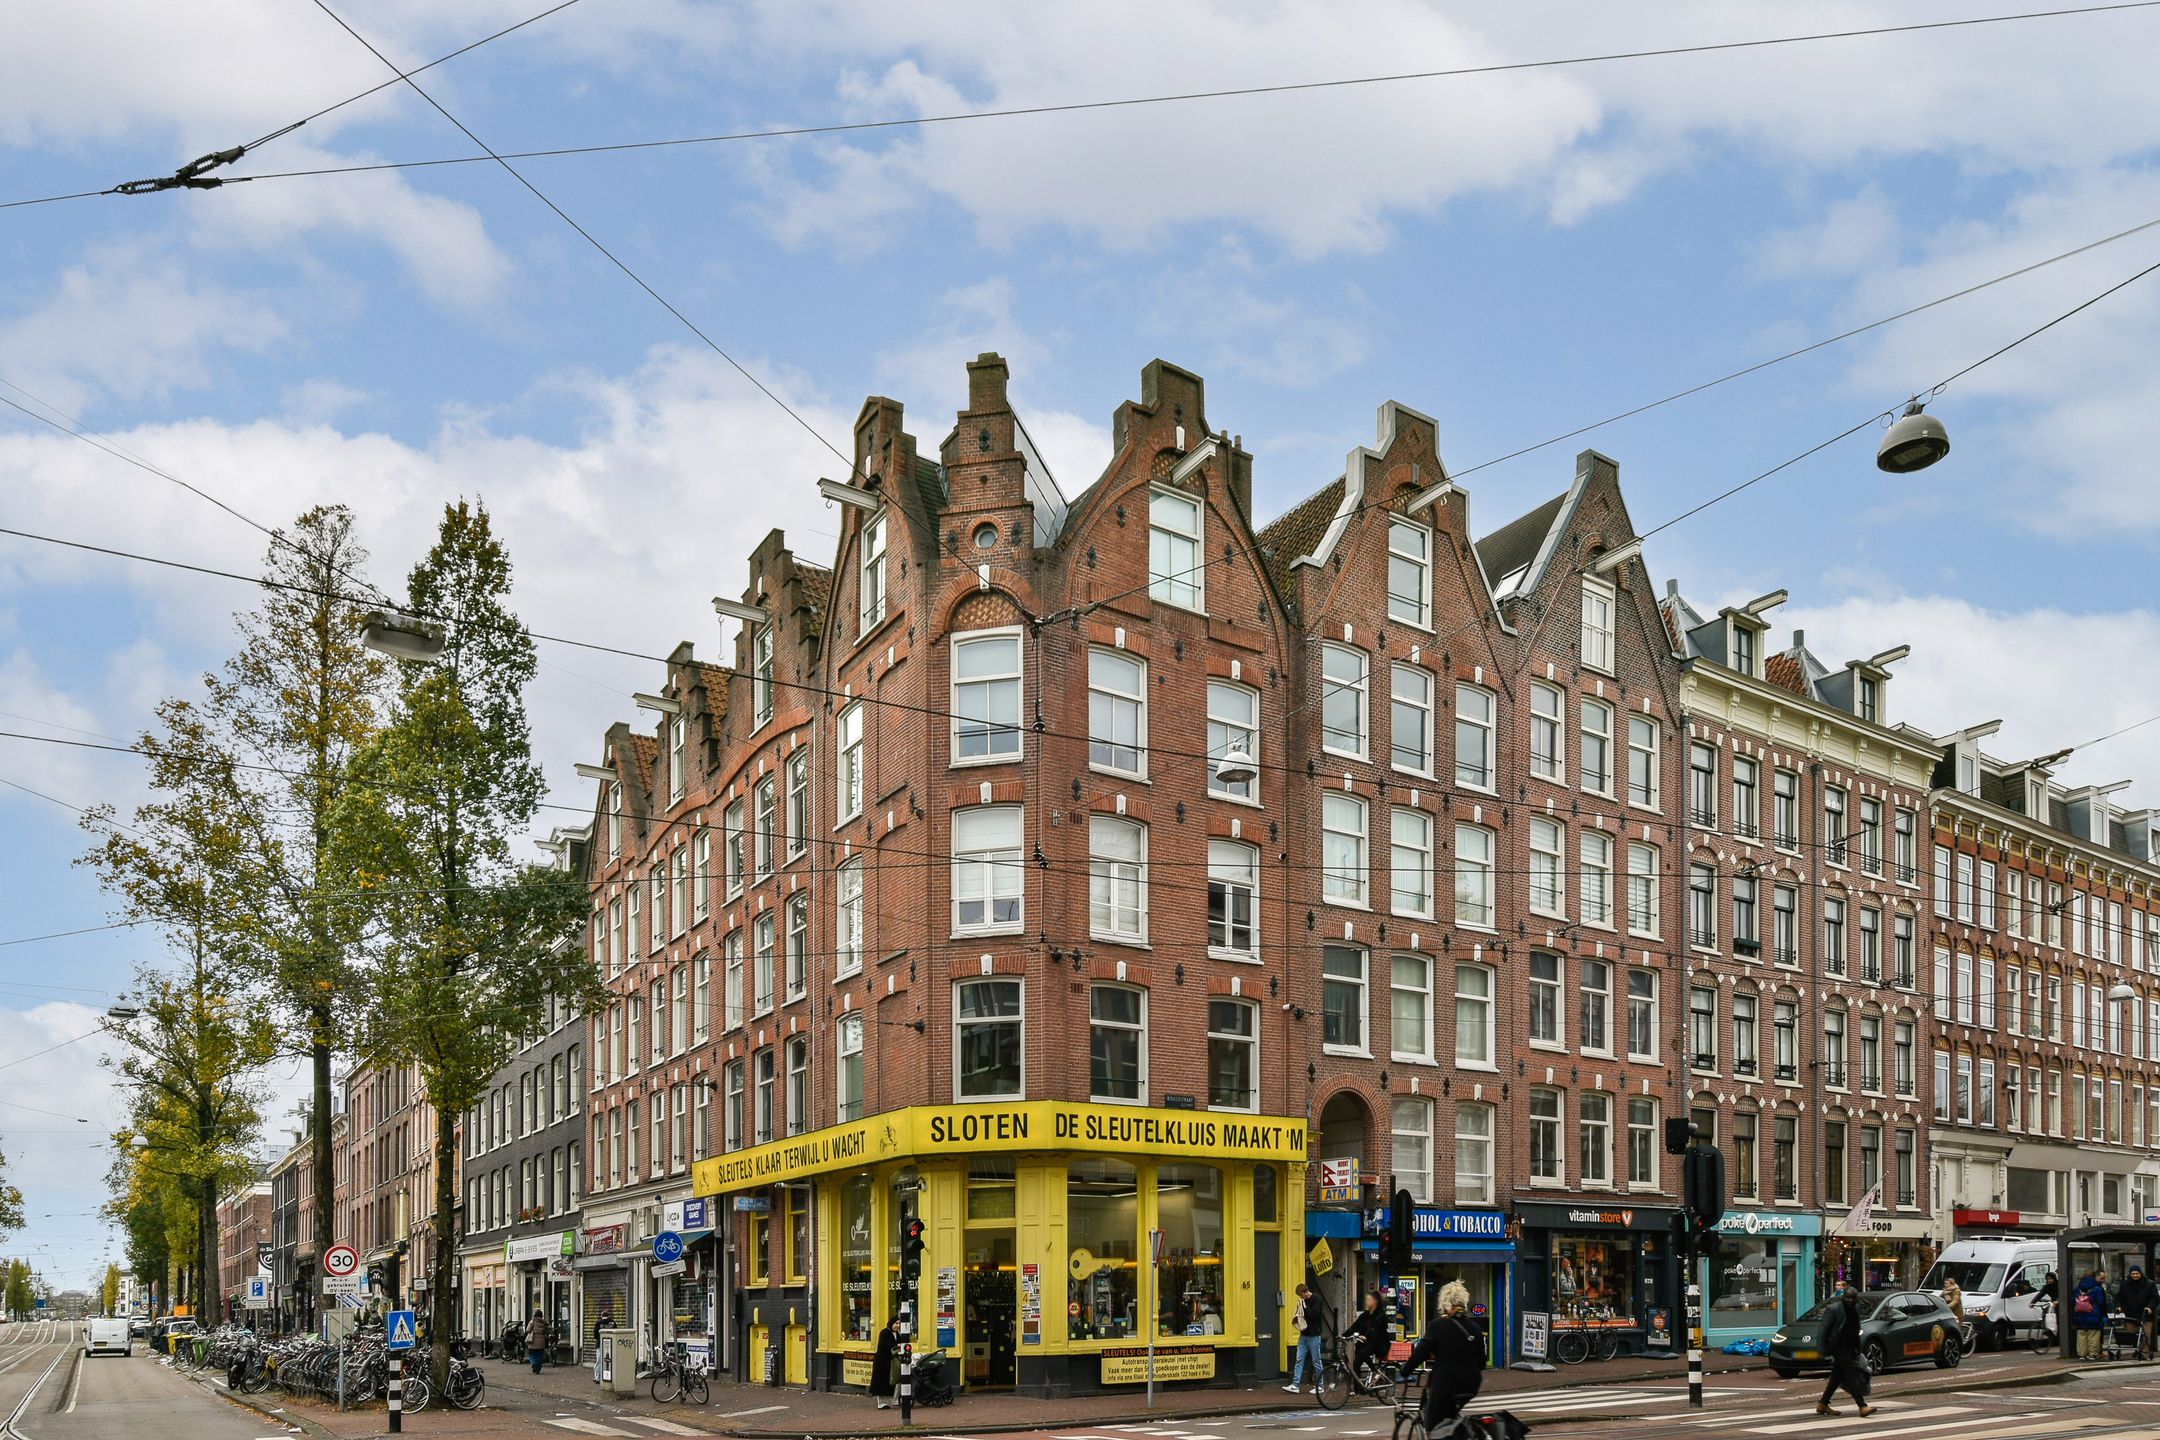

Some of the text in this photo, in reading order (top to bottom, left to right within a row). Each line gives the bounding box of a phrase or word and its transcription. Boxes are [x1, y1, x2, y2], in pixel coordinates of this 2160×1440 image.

[930, 1113, 1028, 1143] SLOTEN
[1055, 1113, 1303, 1151] DE SLEUTELKLUIS MAAKT 'M
[718, 1130, 866, 1184] SLEUTELS KLAAR TERWIJL U WACHT
[1326, 1188, 1347, 1201] ATM
[1569, 1210, 1620, 1223] vitaminstore
[1443, 1217, 1451, 1230] &
[1453, 1215, 1501, 1234] TOBACCO
[1872, 1222, 1893, 1231] FOOD
[331, 1255, 353, 1267] 30
[1242, 1280, 1251, 1289] 65
[1103, 1349, 1136, 1358] SLEUTELS!
[1107, 1367, 1120, 1375] Vaak
[1120, 1366, 1133, 1374] meer
